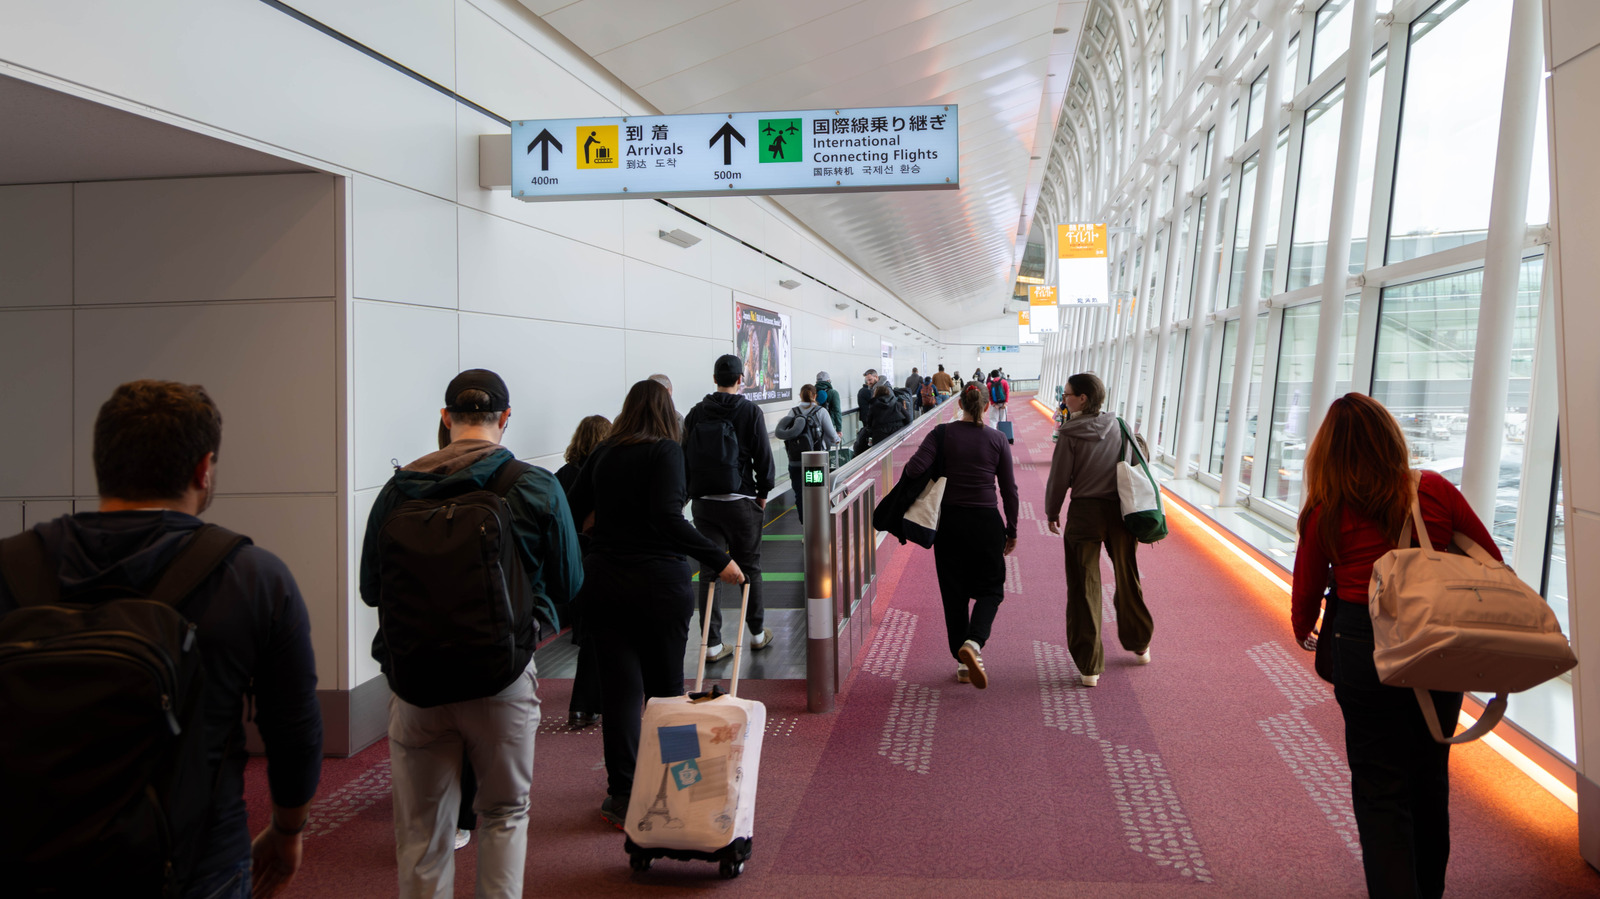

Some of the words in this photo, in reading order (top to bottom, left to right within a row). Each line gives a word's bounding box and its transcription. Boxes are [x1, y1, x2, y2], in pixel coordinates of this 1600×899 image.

[813, 114, 948, 135] 国際線乗り継ぎ
[626, 124, 669, 142] 到着
[813, 134, 901, 149] International
[626, 143, 684, 156] Arrivals
[813, 150, 889, 164] Connecting
[893, 149, 939, 163] Flights
[626, 159, 647, 170] 到达
[655, 158, 678, 168] 도착
[813, 166, 855, 177] 国际转机
[862, 164, 895, 175] 국제선
[899, 164, 922, 175] 환승
[530, 176, 559, 186] 400m
[713, 170, 743, 181] 500m
[805, 470, 823, 483] 自動
